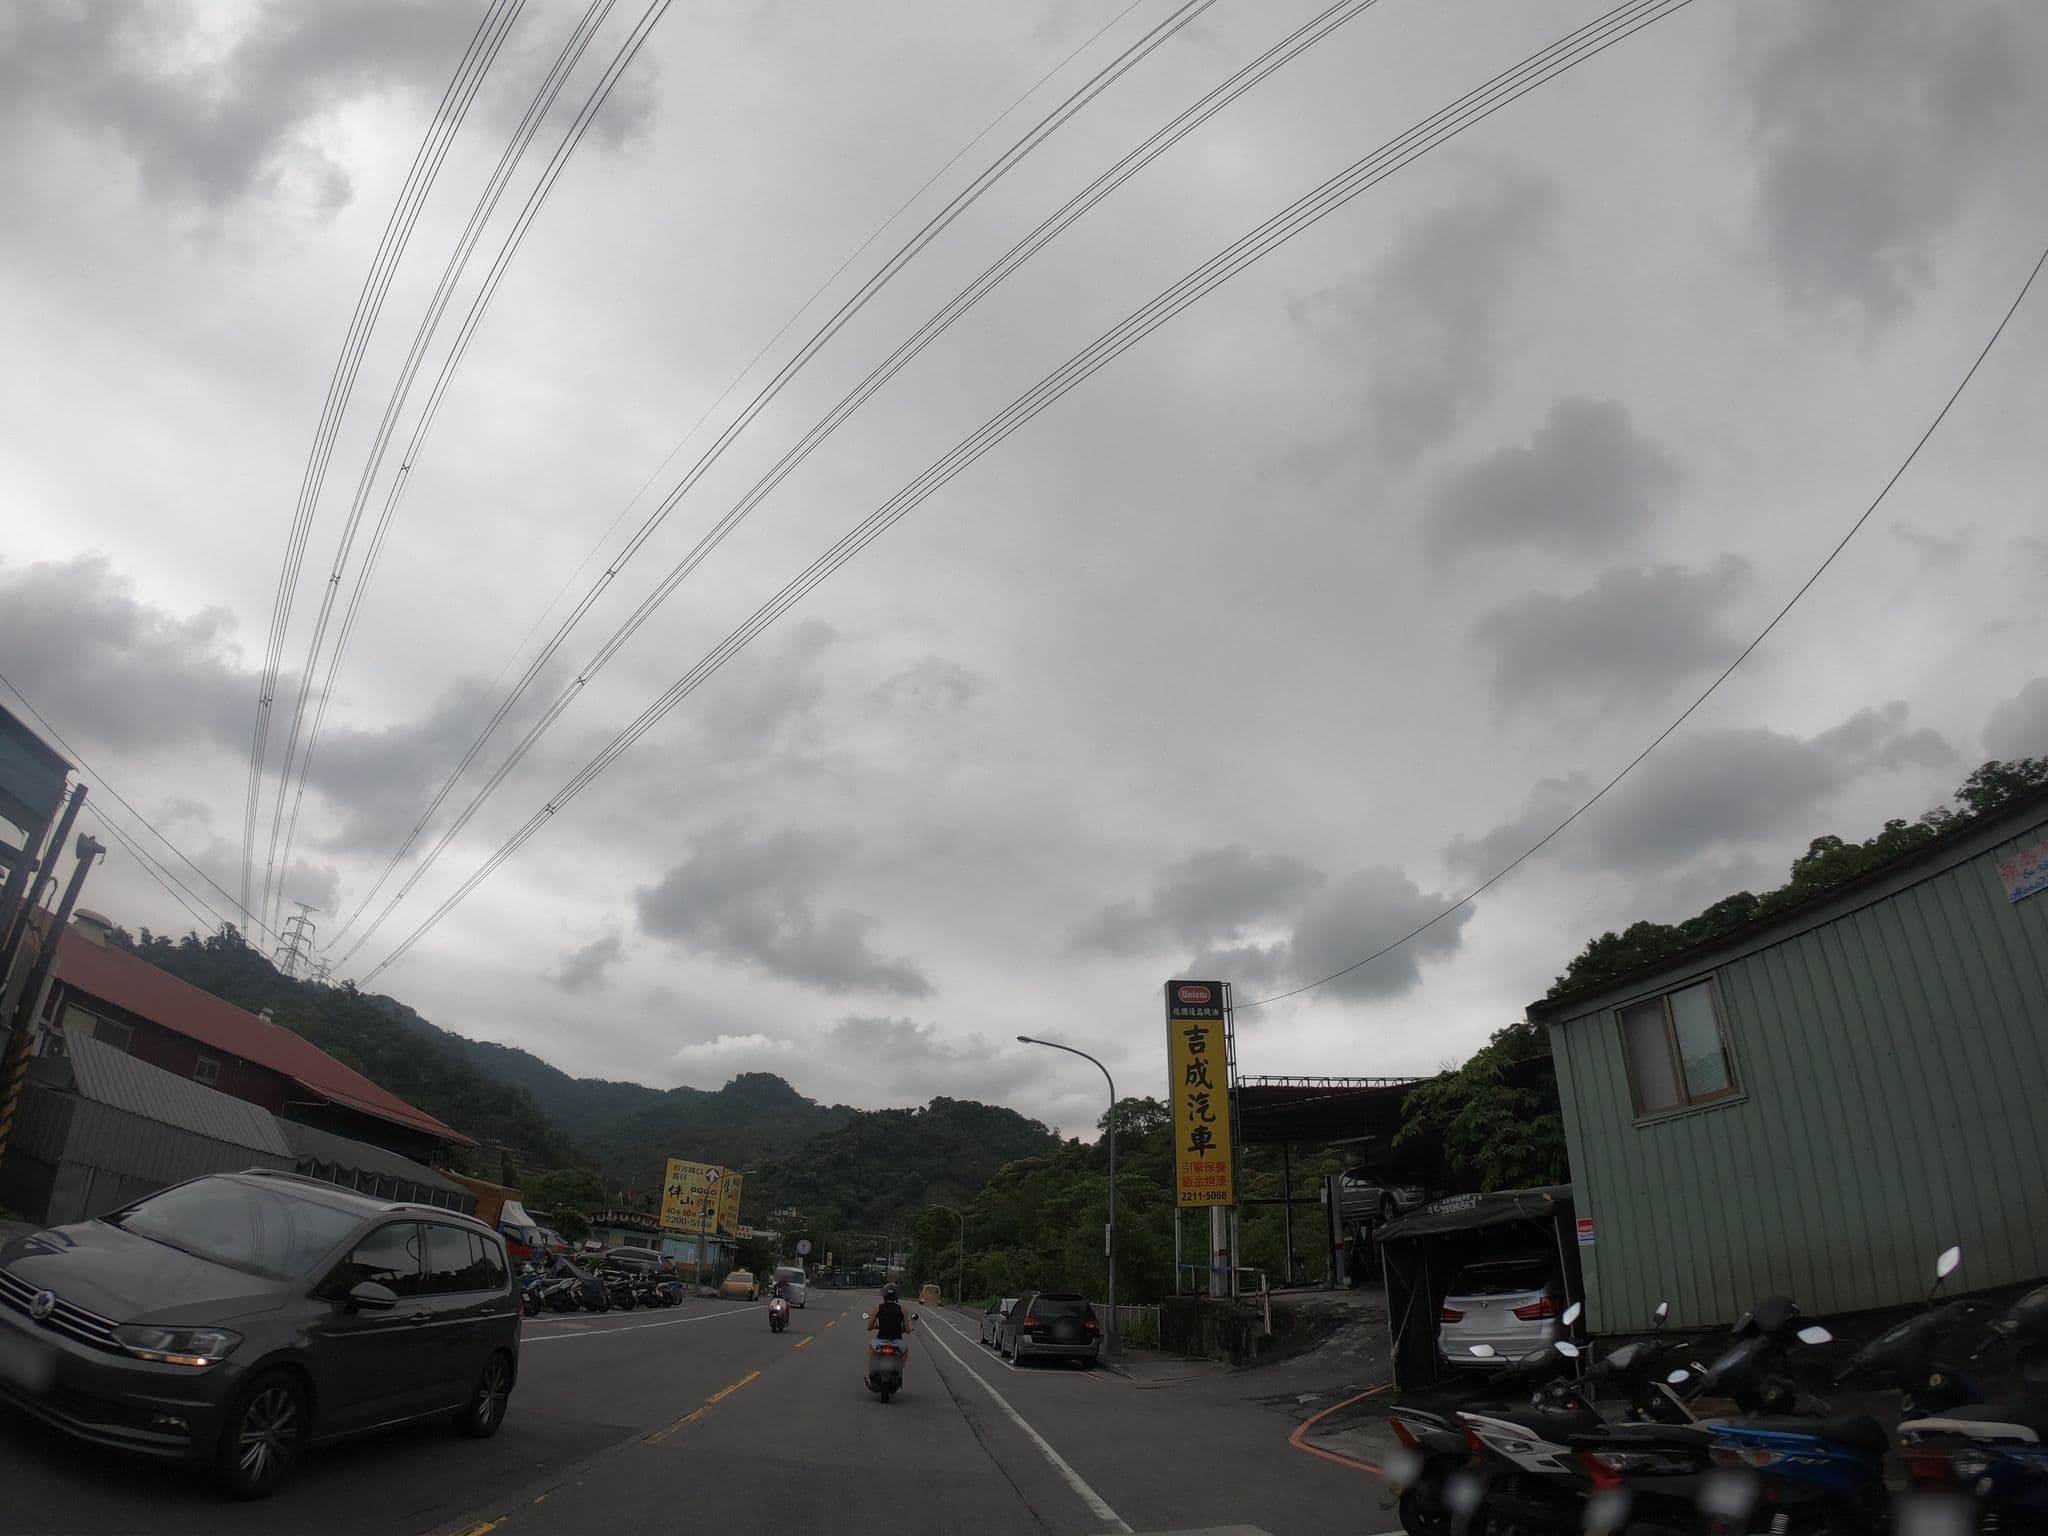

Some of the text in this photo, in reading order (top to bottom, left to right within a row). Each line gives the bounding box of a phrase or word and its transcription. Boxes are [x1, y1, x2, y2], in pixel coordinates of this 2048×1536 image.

[1183, 1024, 1217, 1158] 吉成汽車
[1182, 1161, 1225, 1173] 引擎保養
